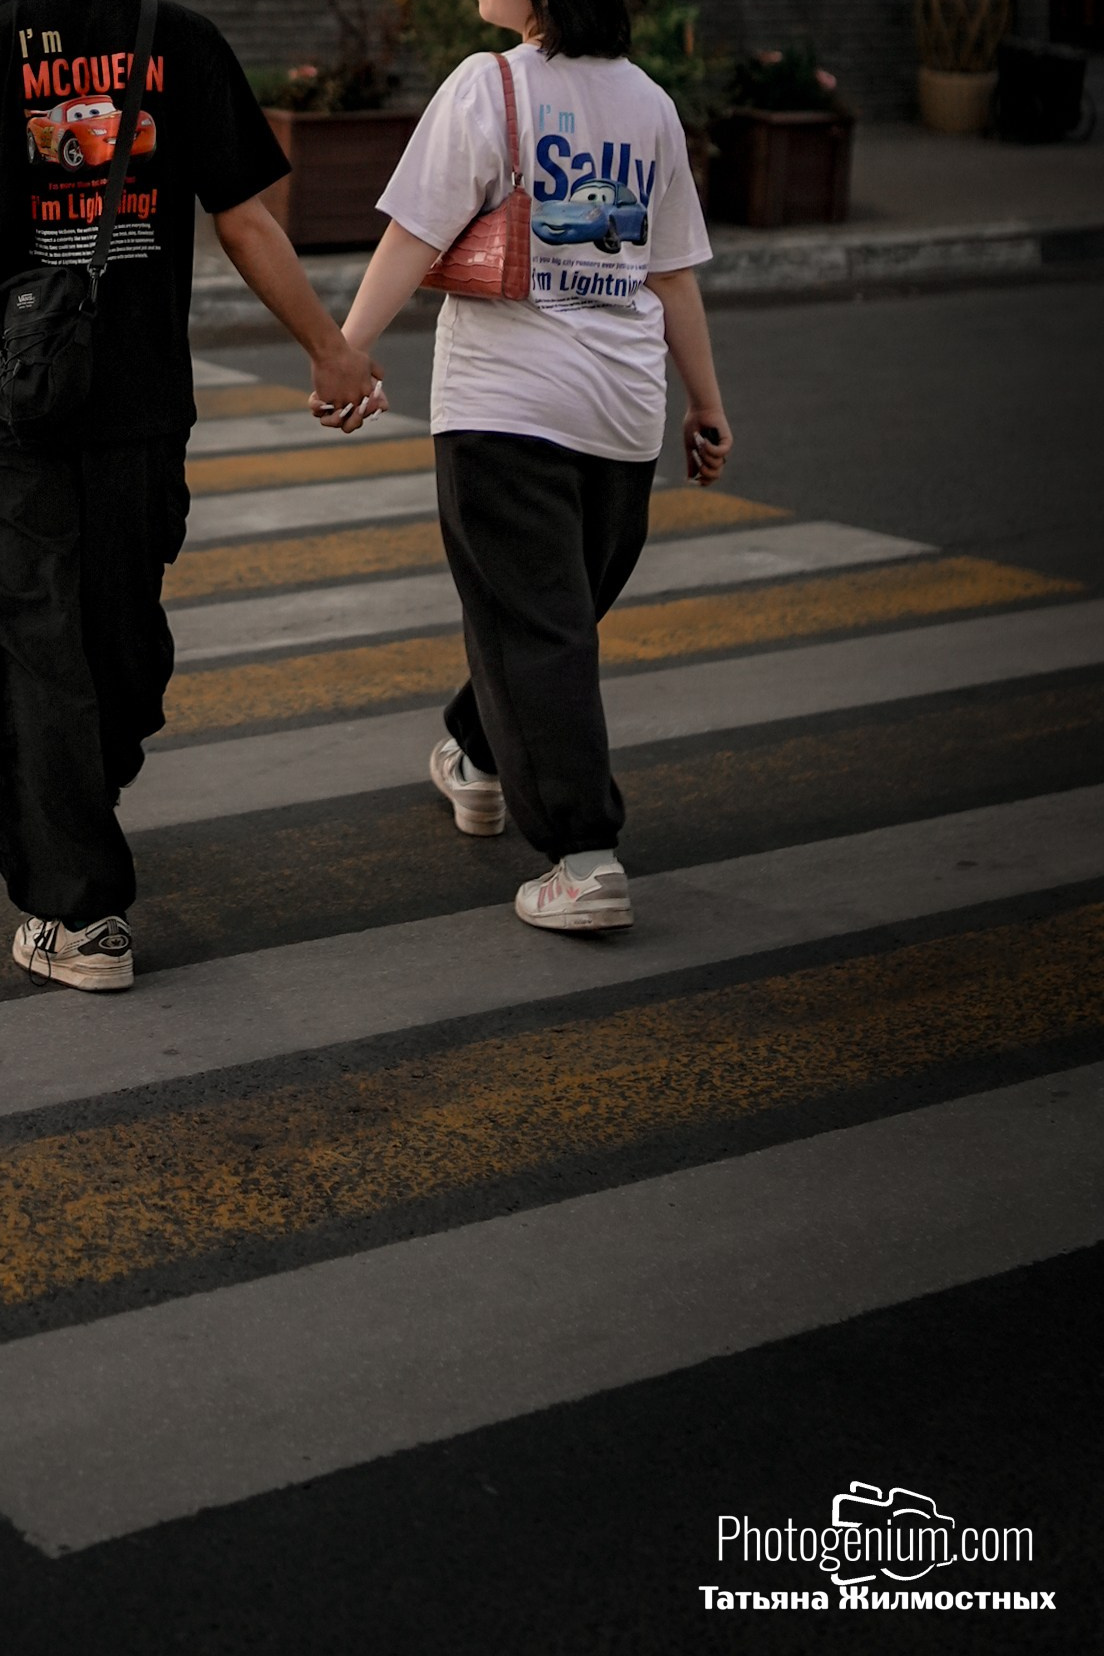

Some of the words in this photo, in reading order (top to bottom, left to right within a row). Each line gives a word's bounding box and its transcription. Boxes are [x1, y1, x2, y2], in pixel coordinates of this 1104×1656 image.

[22, 52, 164, 100] MCQUEN
[533, 134, 656, 209] Sally
[67, 188, 158, 224] Lighing!
